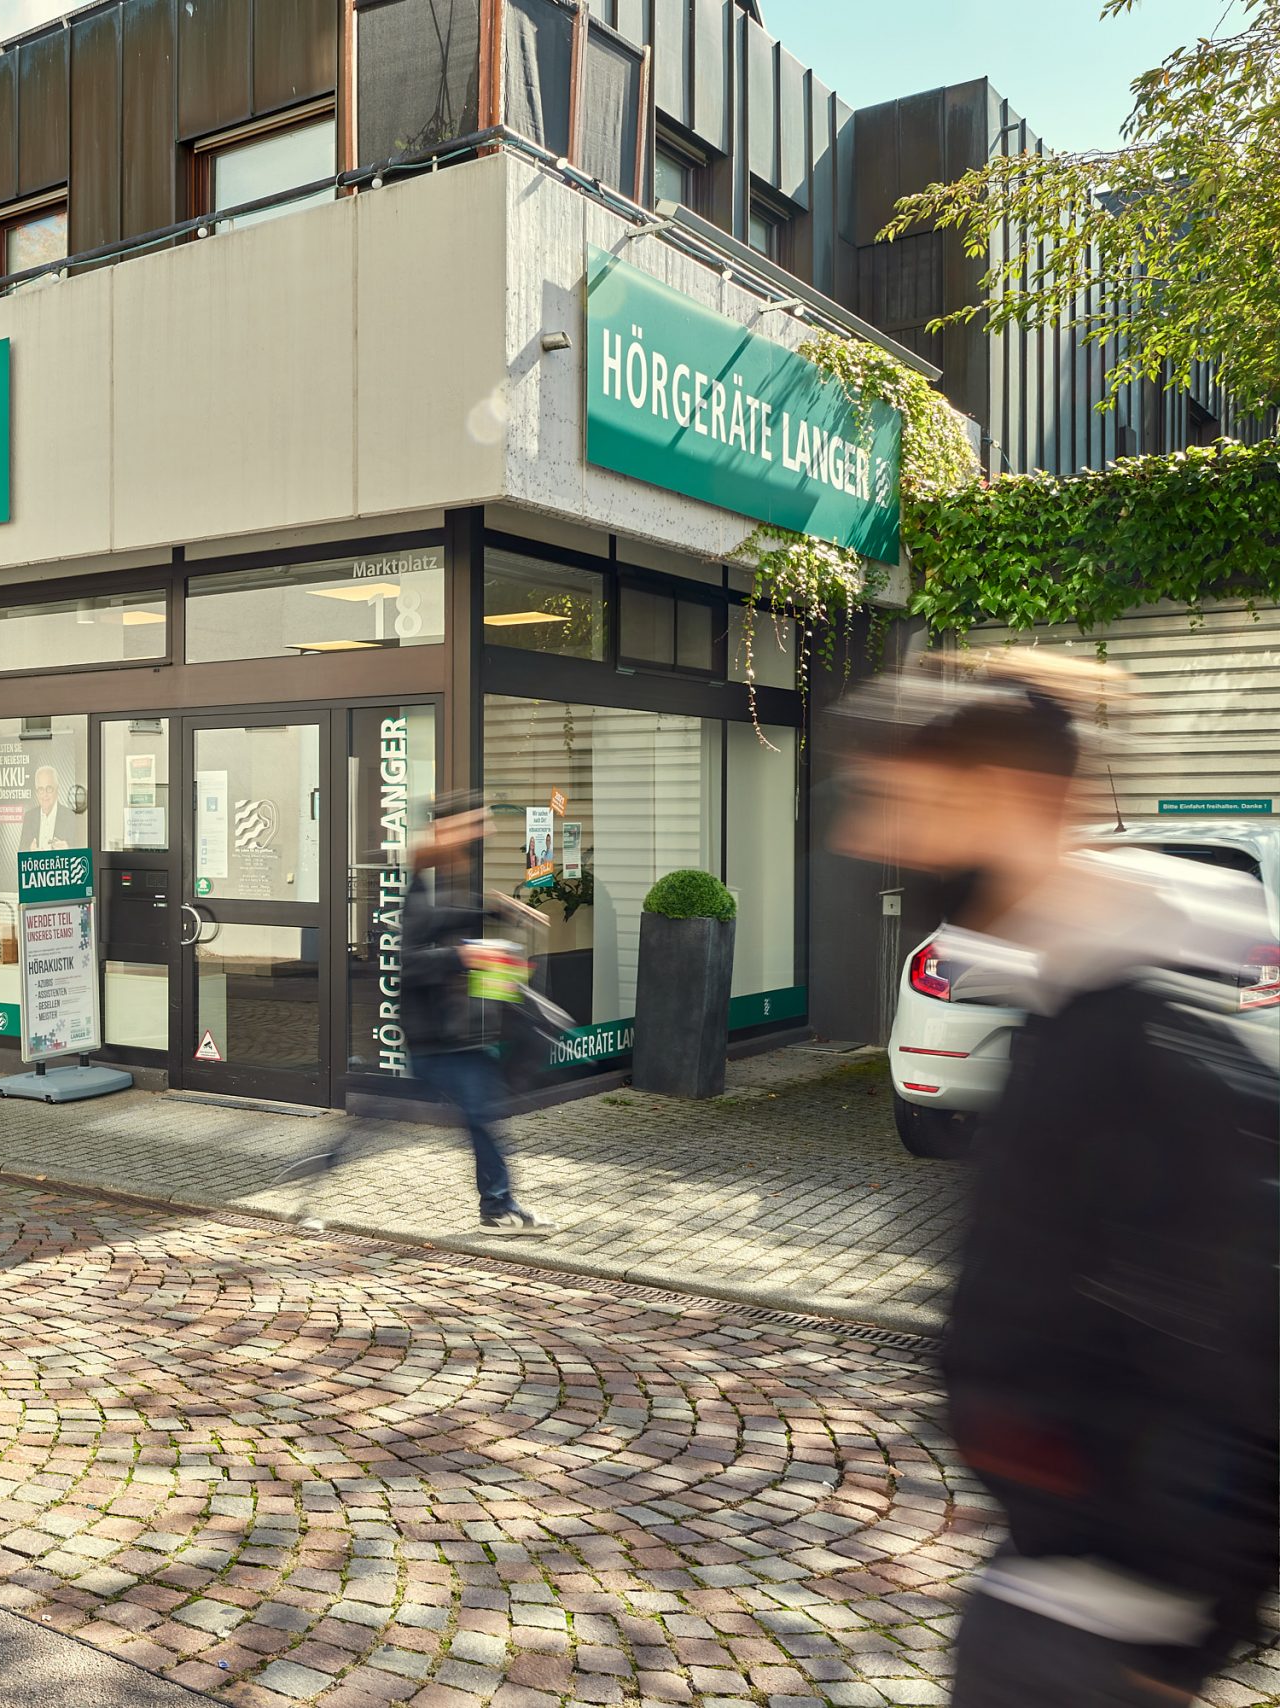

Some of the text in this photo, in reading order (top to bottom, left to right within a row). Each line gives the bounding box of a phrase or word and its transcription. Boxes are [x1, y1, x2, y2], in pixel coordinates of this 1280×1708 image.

[603, 324, 870, 501] HÖRGERÄTE LANGER
[353, 555, 437, 578] Marktplatz
[368, 590, 422, 639] 18
[381, 717, 407, 850] LANGER
[21, 856, 69, 872] HÖRGERÄTE
[22, 870, 70, 889] LANGER
[27, 912, 73, 929] WERDET TEIL
[27, 927, 74, 942] UNSERES TEAMS!
[28, 956, 74, 975] HÖRAKUSTIK
[373, 871, 406, 1070] HÖRGERÄTE
[550, 1027, 636, 1064] HÖRGERÄTE LAN
